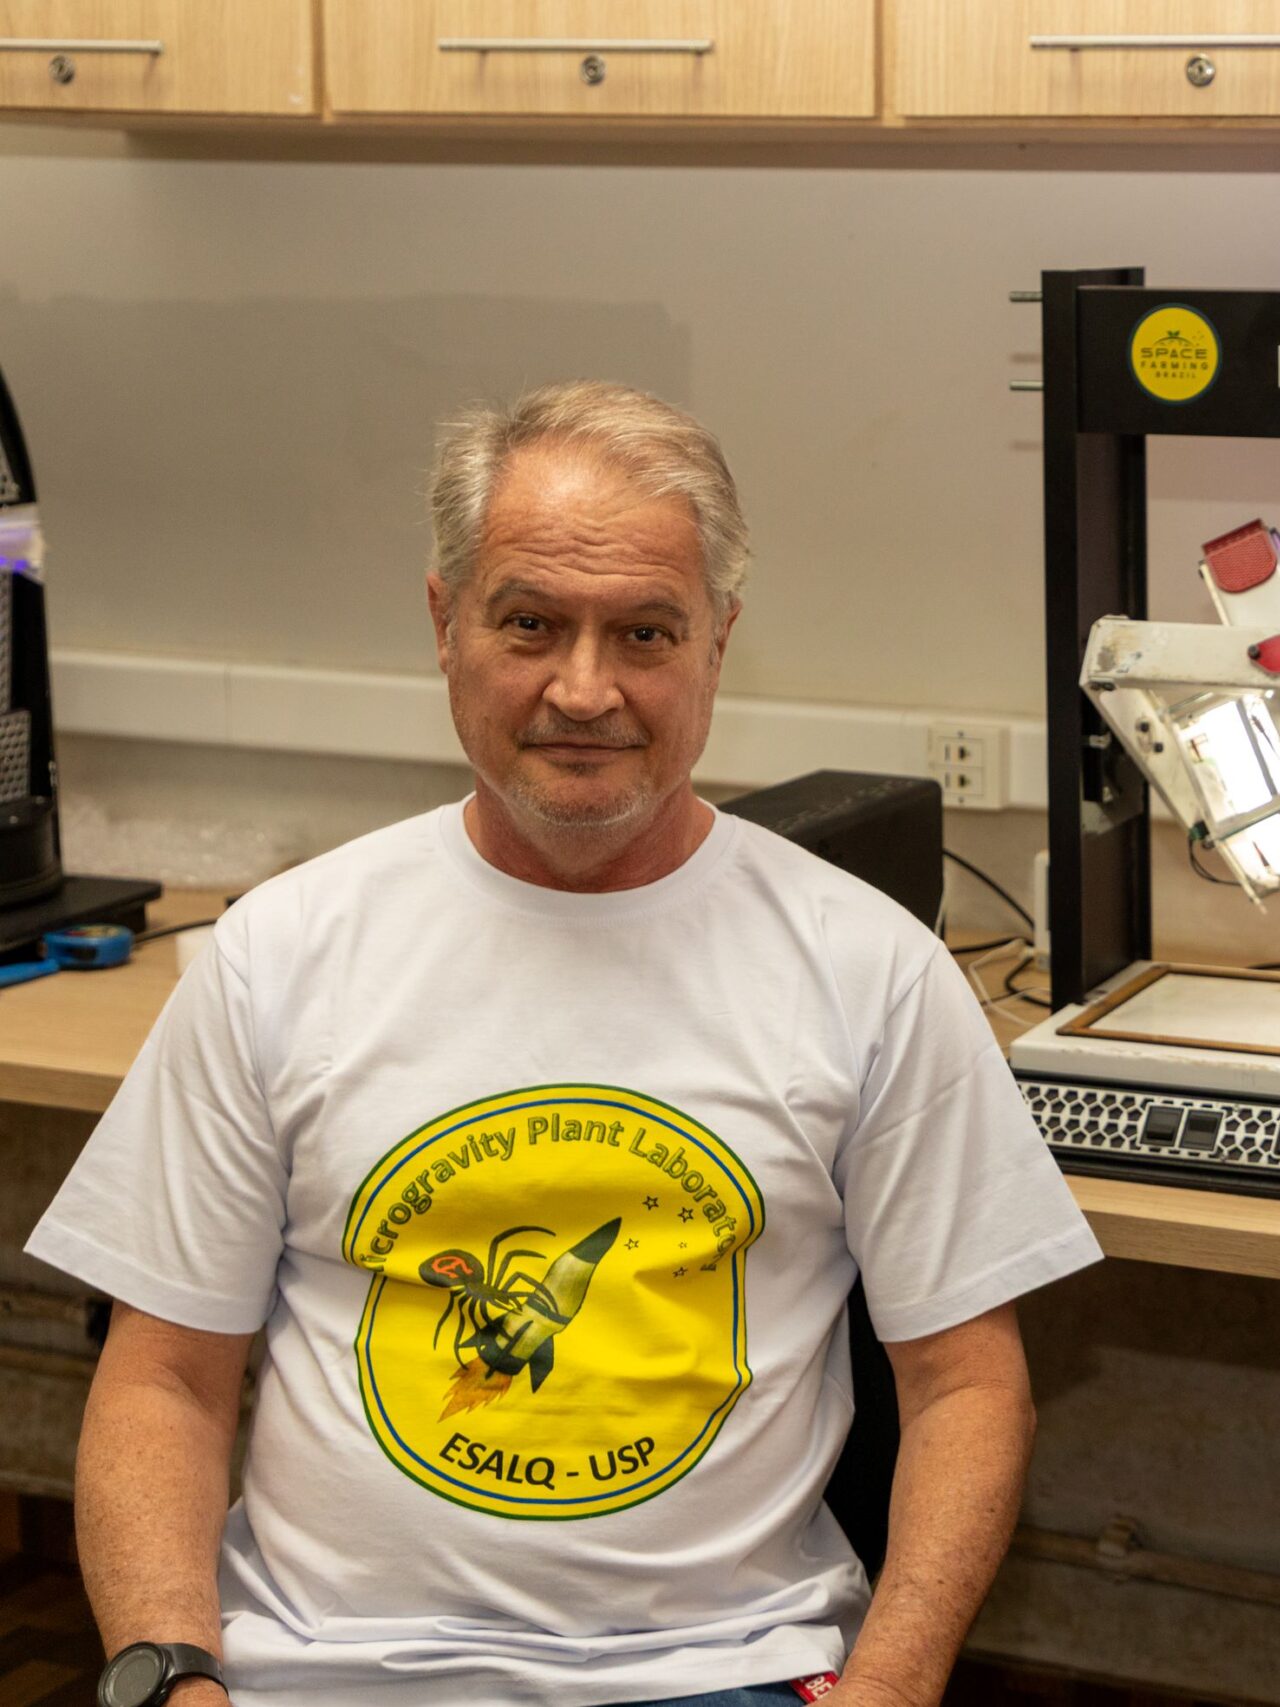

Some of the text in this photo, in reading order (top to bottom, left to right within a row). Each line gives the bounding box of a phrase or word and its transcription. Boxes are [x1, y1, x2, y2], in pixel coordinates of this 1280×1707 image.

[1140, 347, 1208, 359] SPACE
[1140, 361, 1208, 370] FARMING
[527, 1113, 625, 1147] Plant
[439, 1432, 555, 1490] ESALQ
[588, 1436, 655, 1481] USP
